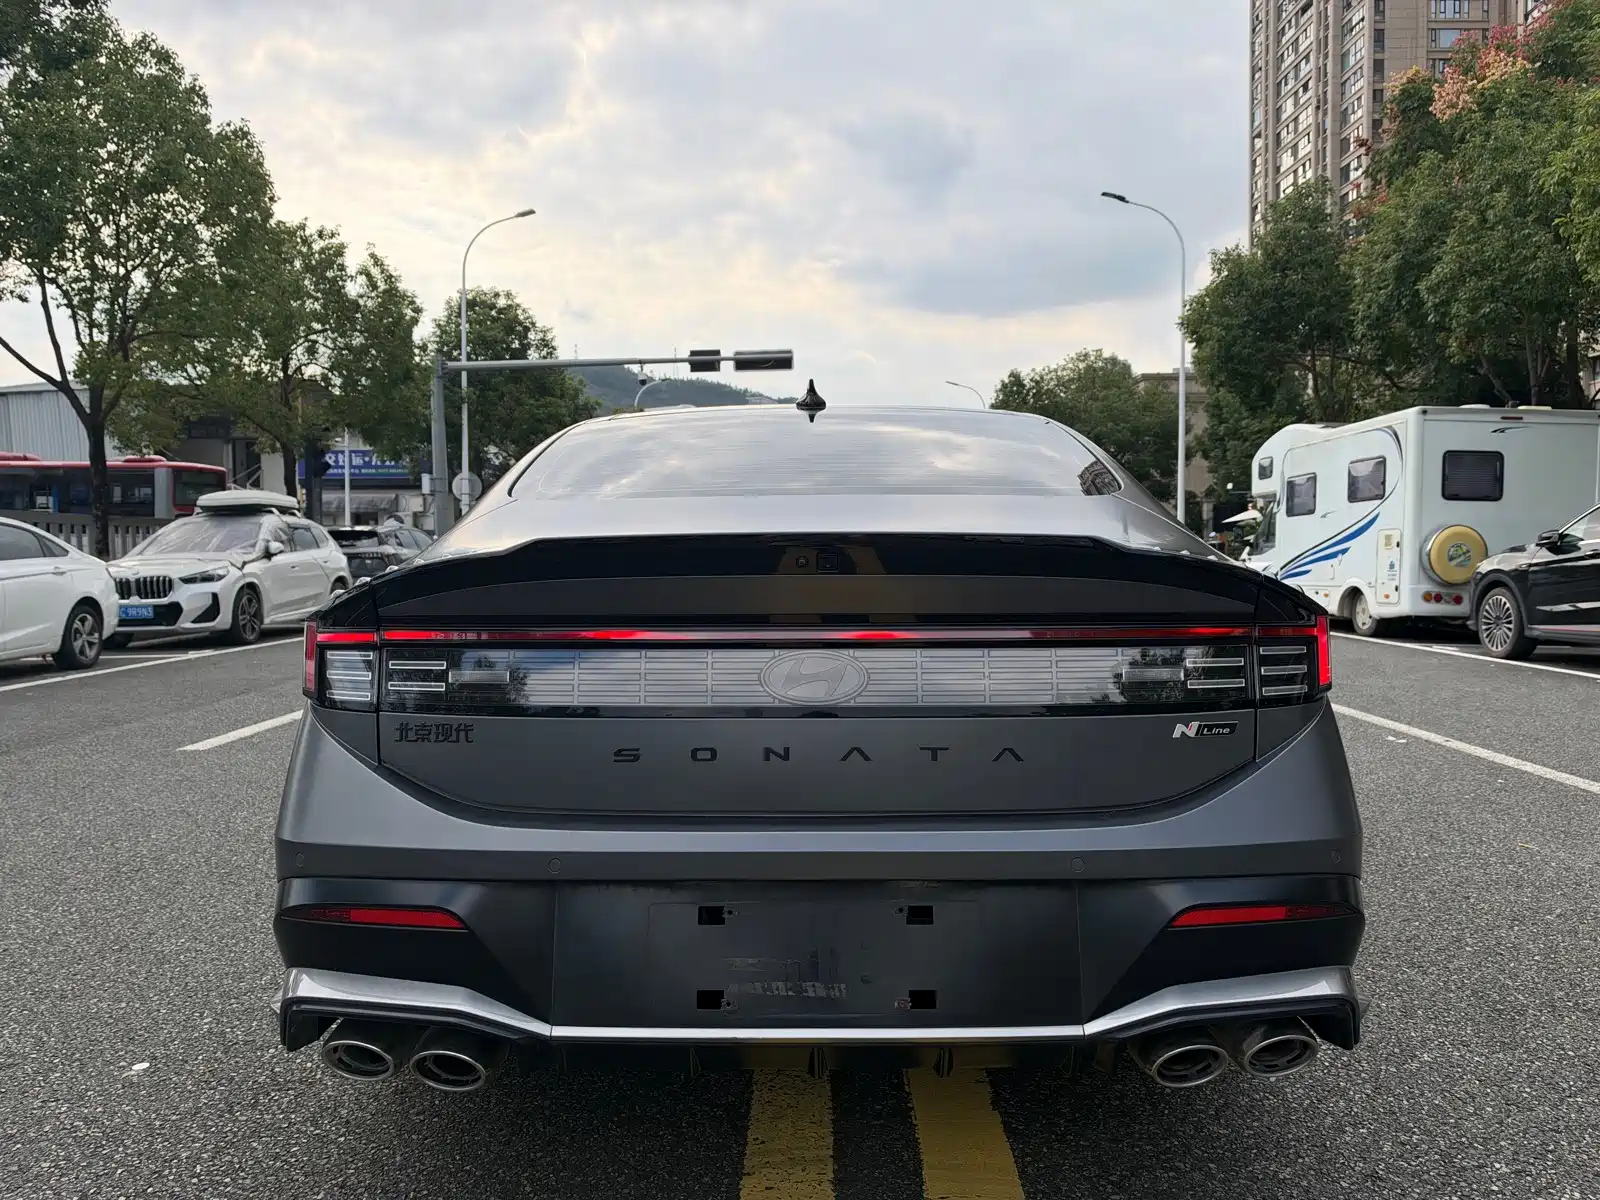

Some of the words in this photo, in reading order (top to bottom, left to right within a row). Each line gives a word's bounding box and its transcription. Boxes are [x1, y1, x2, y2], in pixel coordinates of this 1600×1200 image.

[395, 722, 474, 743] 北京现代
[1173, 721, 1199, 738] N
[1203, 727, 1230, 735] Line
[613, 746, 1024, 763] SONATA
